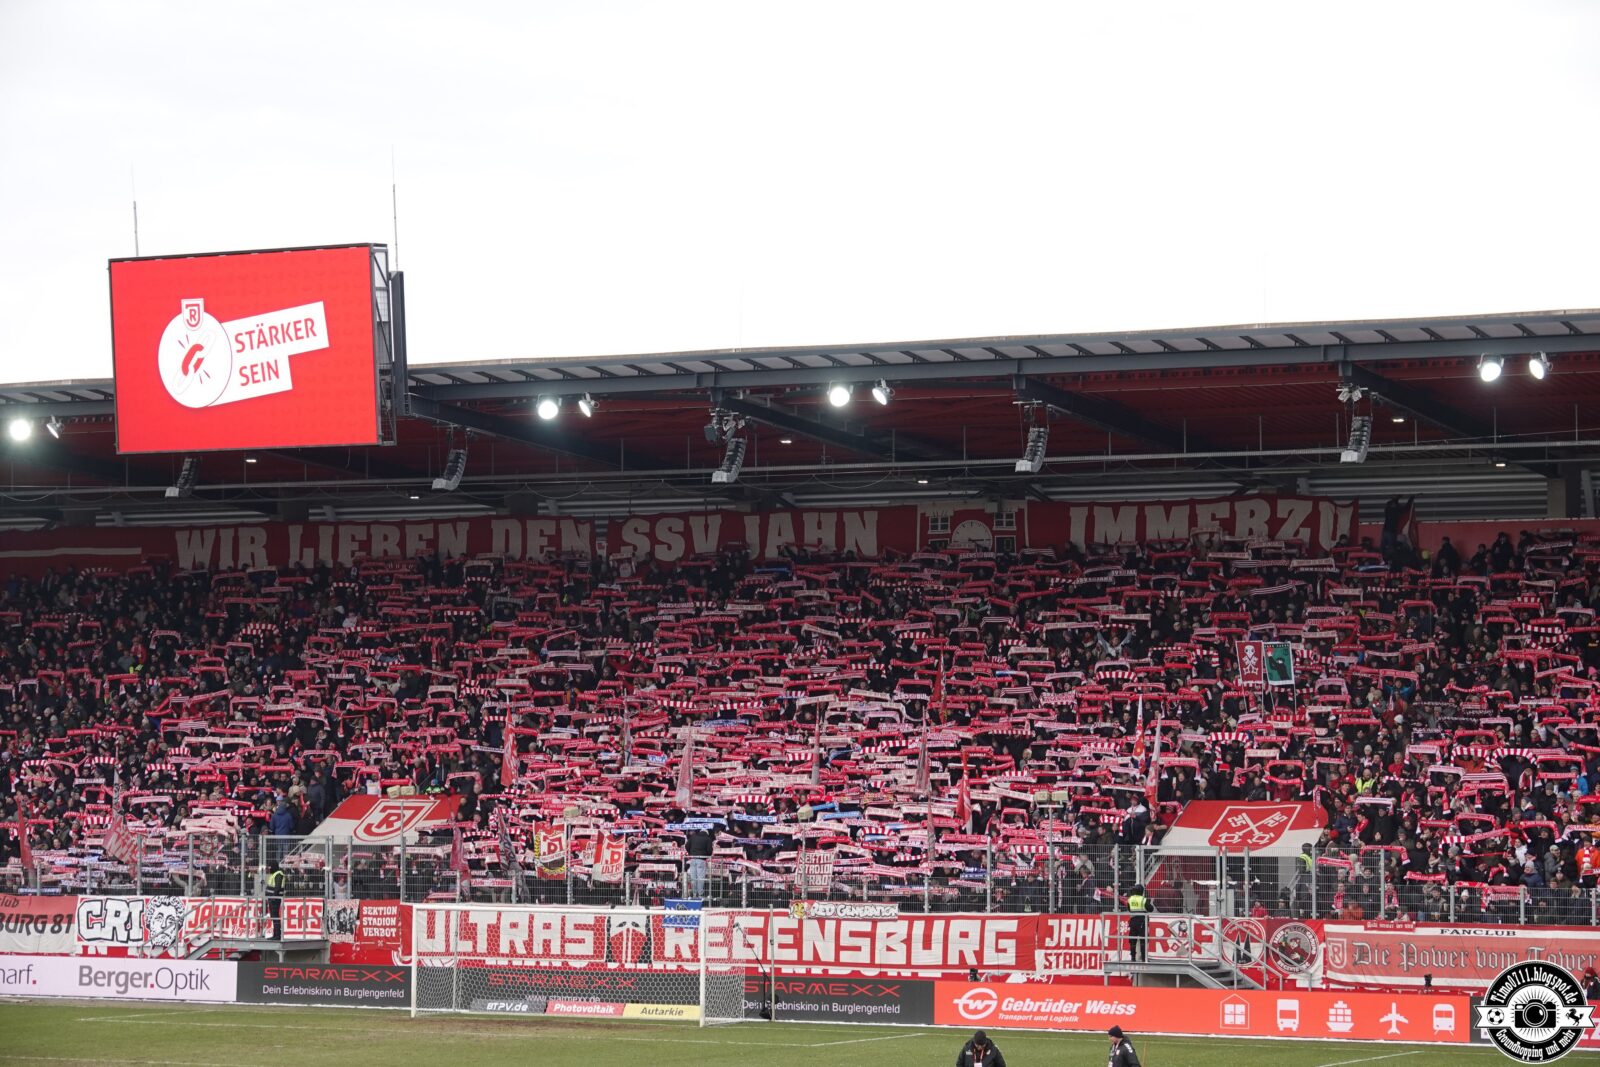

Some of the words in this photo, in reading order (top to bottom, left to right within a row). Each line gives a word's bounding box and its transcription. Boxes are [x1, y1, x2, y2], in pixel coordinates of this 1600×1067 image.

[234, 317, 317, 353] STÄRKER
[239, 359, 280, 387] SEIN
[174, 527, 269, 570] WIR
[490, 518, 591, 562] DEN
[621, 514, 722, 562] SSV
[743, 511, 878, 561] JAHN
[1069, 498, 1354, 551] IMMERZU
[0, 896, 19, 908] lub
[363, 905, 397, 915] SEKTION
[50, 913, 73, 934] 81
[363, 916, 396, 926] STADION
[363, 927, 396, 937] VERBOT
[417, 910, 595, 956] ULTRAS
[664, 911, 1018, 966] REGENSBURG
[1045, 918, 1110, 947] JAHN
[1440, 928, 1517, 937] FANCLUB
[1352, 942, 1391, 966] Die
[1399, 942, 1463, 971] Power
[1475, 945, 1518, 969] vom
[264, 967, 405, 982] STARMEXX
[263, 985, 281, 994] Dein
[283, 986, 332, 996] Erlebniskino
[334, 987, 342, 996] in
[344, 988, 405, 999] Burglengenfeld
[553, 1003, 615, 1014] Photovoltaik
[640, 1007, 684, 1016] Autarkie
[821, 1003, 830, 1012] in
[832, 1003, 901, 1015] Burglengenfeld
[1001, 997, 1082, 1013] Gebrüder
[1085, 1000, 1137, 1016] Weiss
[998, 1013, 1032, 1021] Transport
[1049, 1015, 1080, 1023] Logistik
